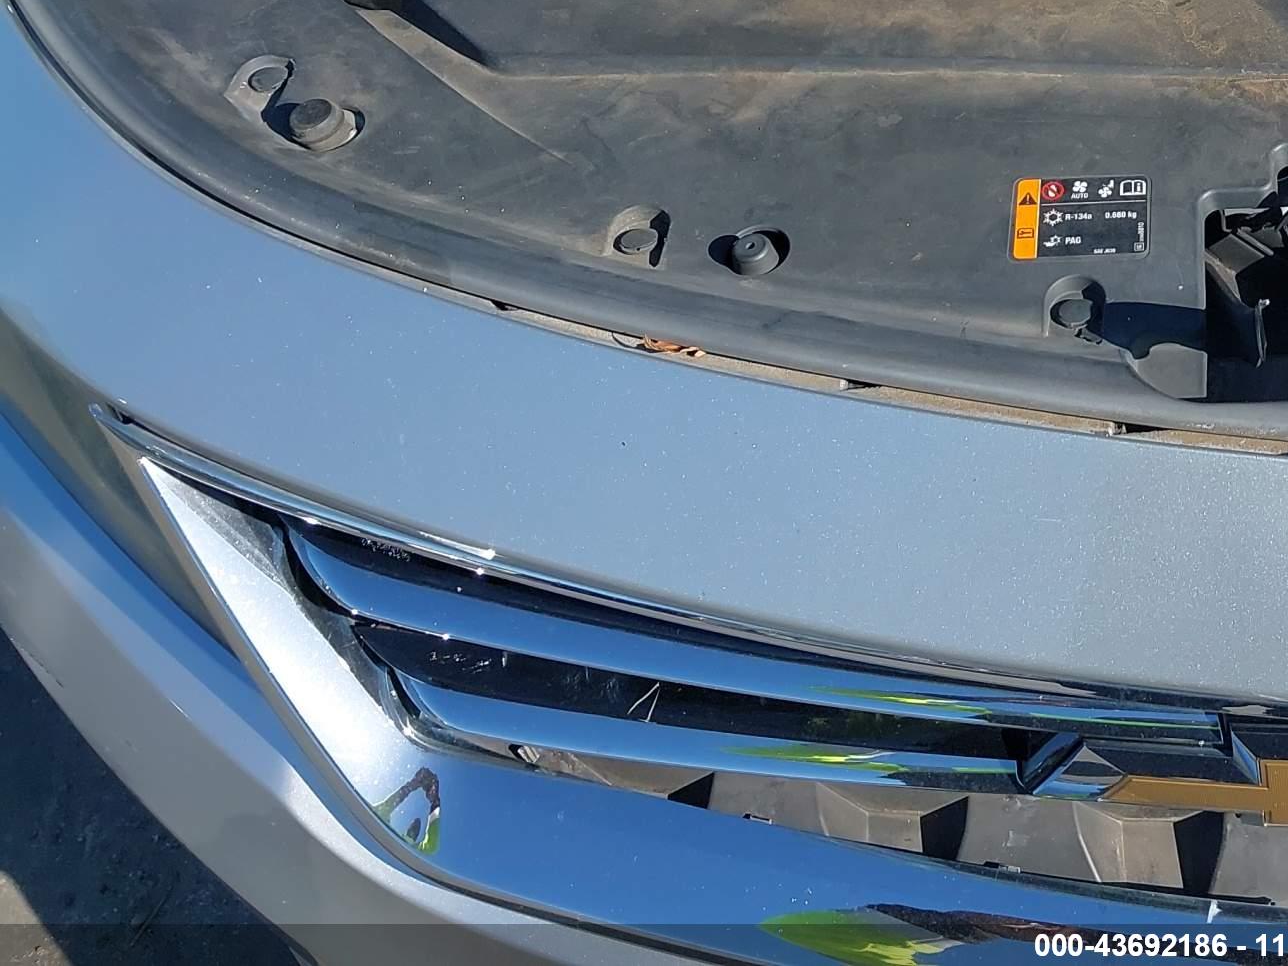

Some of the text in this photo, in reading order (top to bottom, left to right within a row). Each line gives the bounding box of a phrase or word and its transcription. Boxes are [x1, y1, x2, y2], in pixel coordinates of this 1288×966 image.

[1064, 212, 1093, 221] R-134a
[1127, 210, 1137, 220] kg
[1065, 236, 1082, 245] PAG
